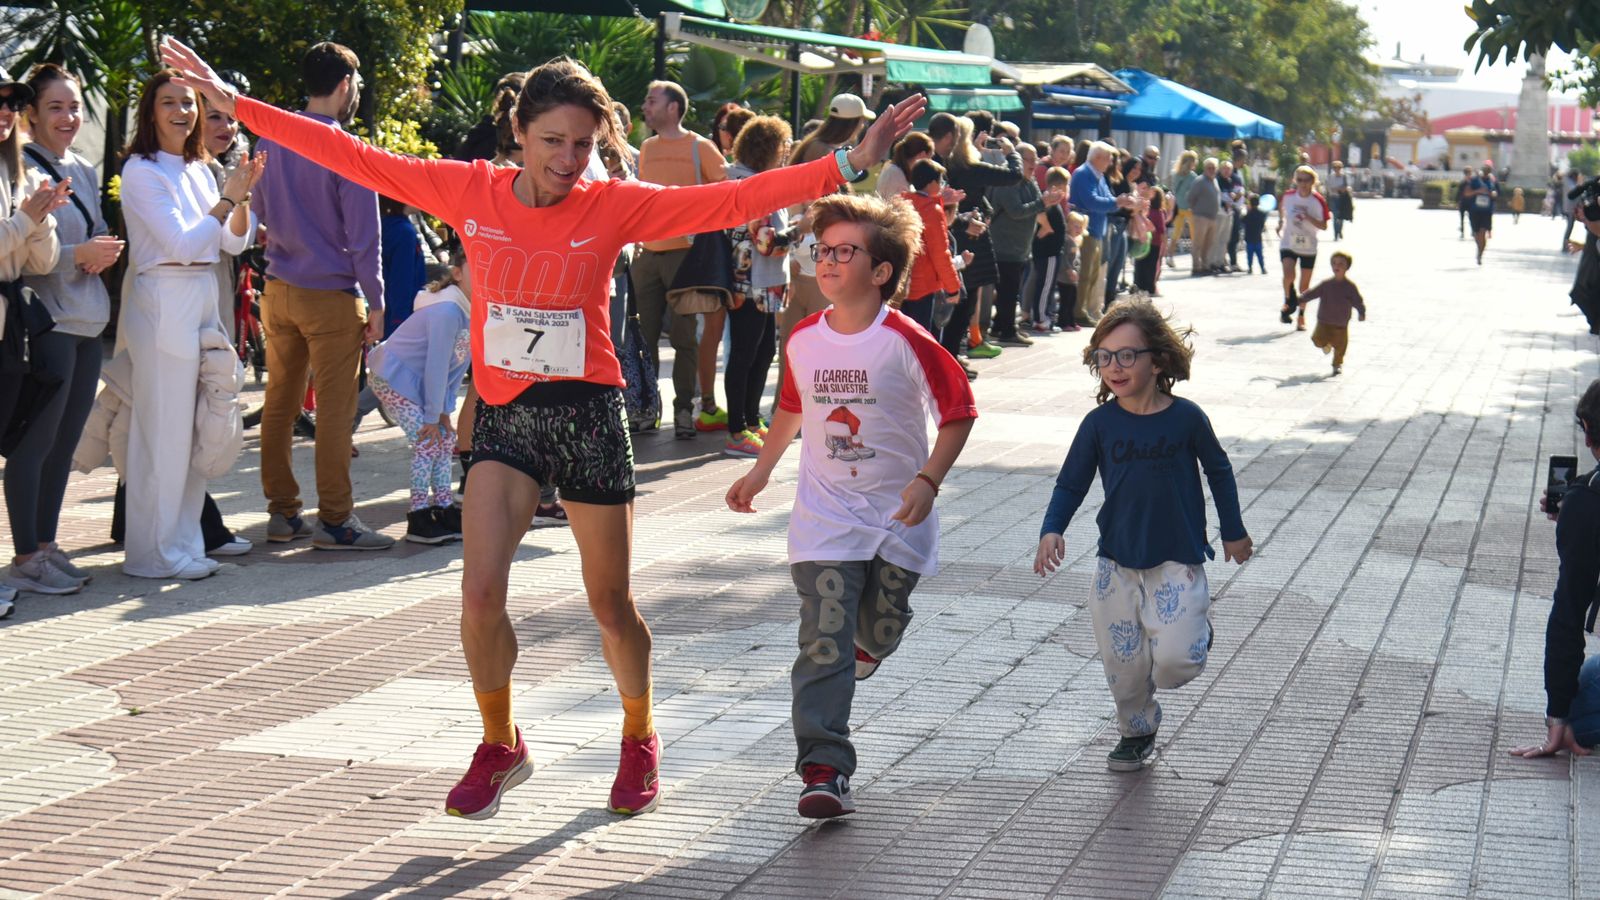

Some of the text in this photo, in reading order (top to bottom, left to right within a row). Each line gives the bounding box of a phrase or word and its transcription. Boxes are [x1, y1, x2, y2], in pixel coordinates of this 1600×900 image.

[469, 240, 599, 306] GOOD
[512, 308, 532, 318] SAN
[533, 309, 580, 320] SILVESTRE
[515, 317, 550, 327] TARIFEÑA
[523, 327, 545, 354] 7
[813, 369, 868, 384] II CARRERA
[814, 383, 869, 394] SAN SILVESTRE
